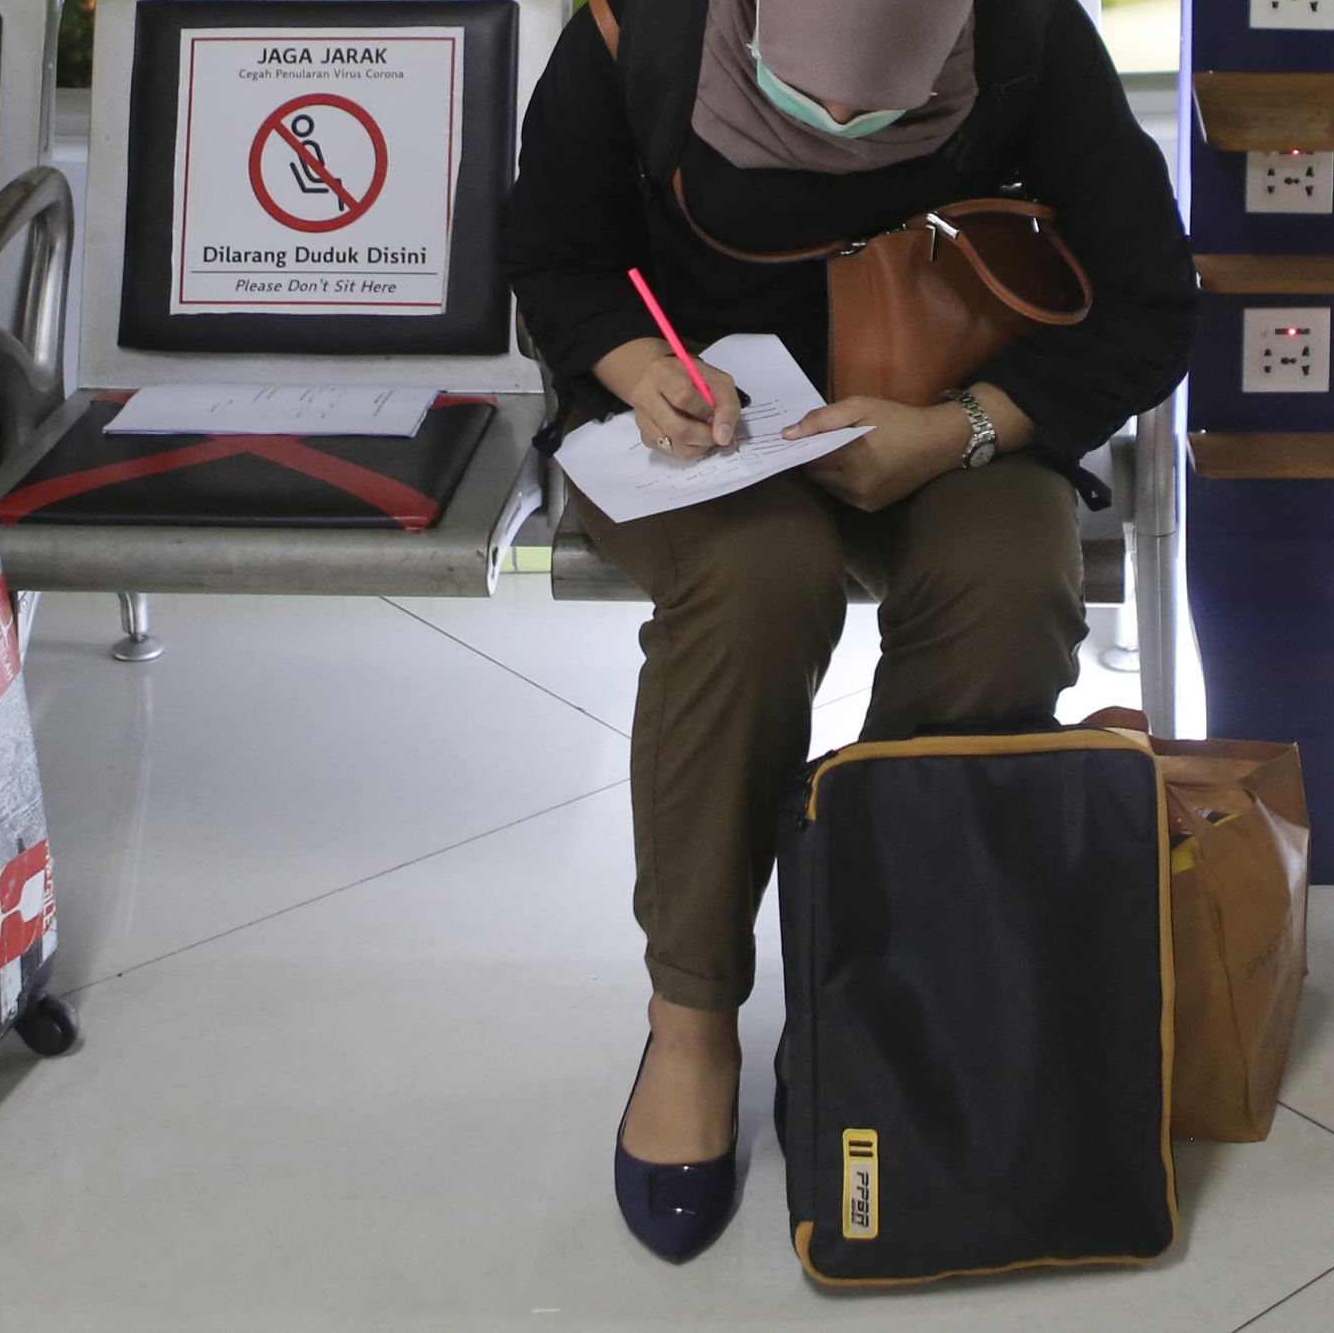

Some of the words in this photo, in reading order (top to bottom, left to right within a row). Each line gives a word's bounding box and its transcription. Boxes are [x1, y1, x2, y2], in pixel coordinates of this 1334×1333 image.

[257, 48, 312, 64] JAGA
[320, 48, 387, 64] JARAK
[239, 69, 272, 81] Cegah
[275, 69, 330, 79] Penularan
[333, 69, 362, 79] Virus
[365, 69, 404, 79] Corona
[203, 246, 287, 267] Dilarang
[295, 246, 358, 264] Duduk
[367, 247, 427, 264] Disini
[235, 279, 283, 292] Please
[287, 279, 328, 292] Don't
[334, 280, 355, 292] Sit
[361, 280, 397, 293] Here
